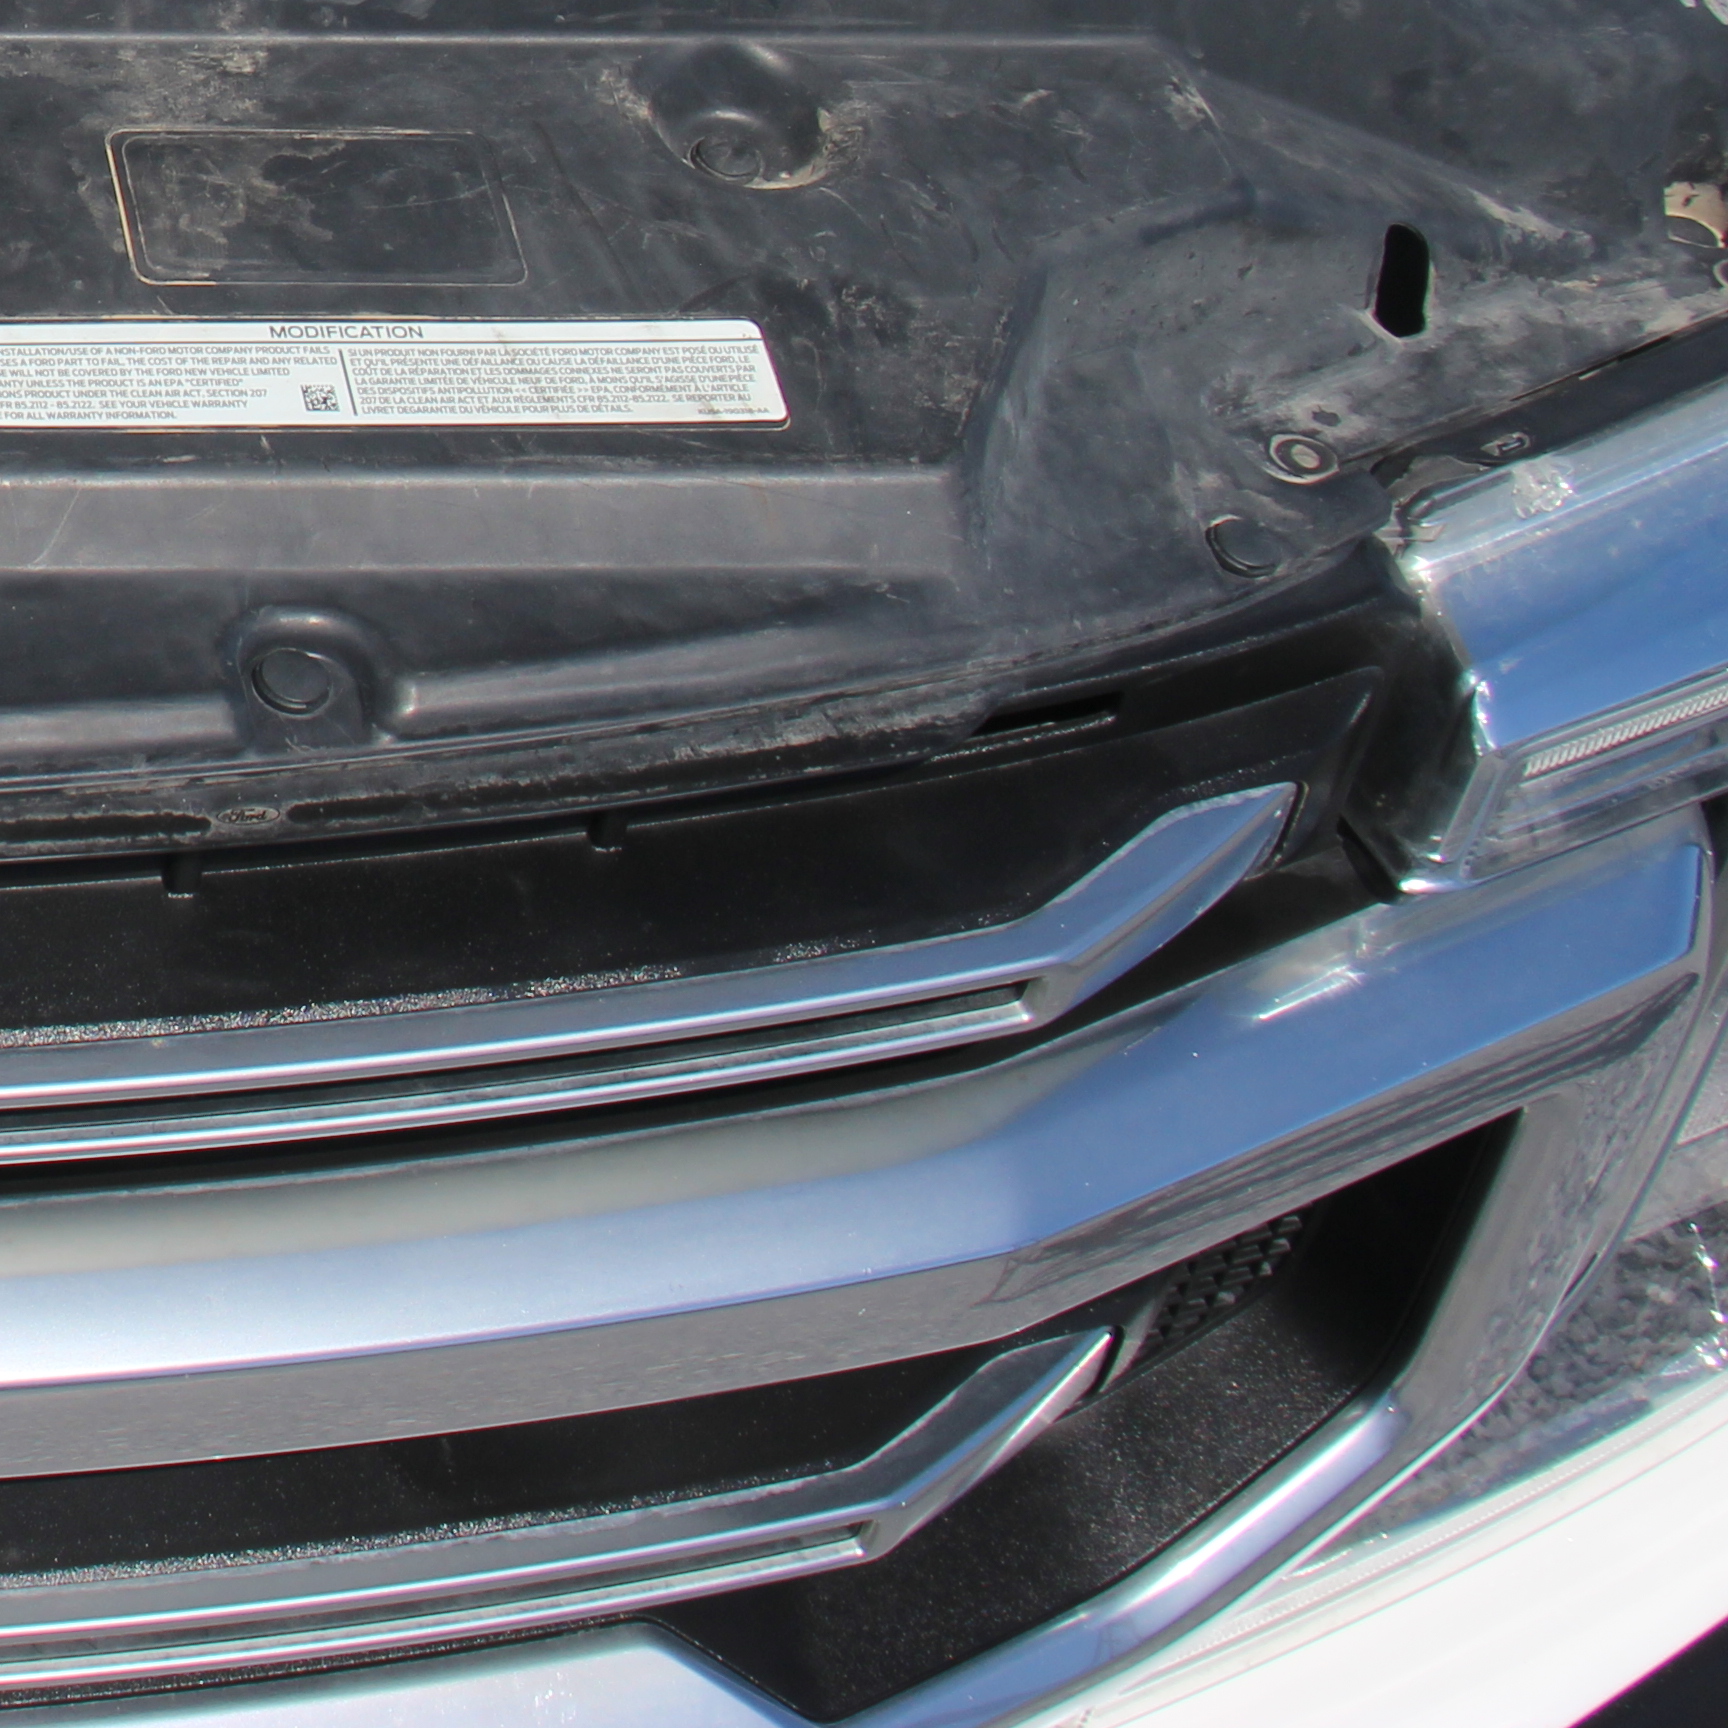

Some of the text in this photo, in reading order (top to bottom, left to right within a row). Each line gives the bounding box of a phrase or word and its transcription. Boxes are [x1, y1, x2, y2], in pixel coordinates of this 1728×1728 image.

[269, 325, 423, 339] MODIFICATION
[90, 347, 104, 356] OF
[114, 347, 167, 355] NON-FORD
[167, 347, 204, 355] MOTOR
[205, 346, 253, 355] COMPANY
[255, 346, 301, 354] PRODUCT
[303, 346, 329, 354] FAILS
[28, 358, 56, 367] FORD
[57, 358, 83, 366] PART
[86, 357, 100, 366] TO
[127, 357, 146, 366] THE
[147, 357, 173, 366] COST
[175, 357, 189, 365] OF
[191, 356, 210, 365] THE
[211, 356, 247, 365] REPAIR
[248, 356, 270, 365] AND
[271, 356, 292, 364] ANY
[293, 355, 336, 364] RELATED
[9, 369, 32, 377] WILL
[34, 368, 55, 377] NOT
[57, 368, 70, 377] BE
[72, 368, 118, 377] COVERED
[119, 368, 133, 377] BY
[135, 368, 154, 377] THE
[156, 368, 183, 376] FORD
[184, 367, 208, 376] NEW
[209, 367, 250, 376] VEHICLE
[251, 367, 289, 376] LIMITED
[26, 379, 65, 388] UNLESS
[67, 379, 86, 388] THE
[87, 378, 134, 387] PRODUCT
[136, 378, 146, 387] IS
[148, 378, 163, 387] AN
[163, 378, 184, 387] EPA
[24, 389, 71, 398] PRODUCT
[73, 389, 107, 398] UNDER
[110, 389, 129, 398] THE
[130, 389, 163, 398] CLEAN
[164, 389, 181, 397] AIR
[206, 388, 248, 397] SECTION
[99, 400, 117, 409] SEE
[119, 400, 147, 408] YOUR
[149, 399, 190, 408] VEHICLE
[191, 399, 247, 408] WARRANTY
[4, 411, 24, 419] FOR
[26, 411, 43, 419] ALL
[46, 410, 103, 419] WARRANTY
